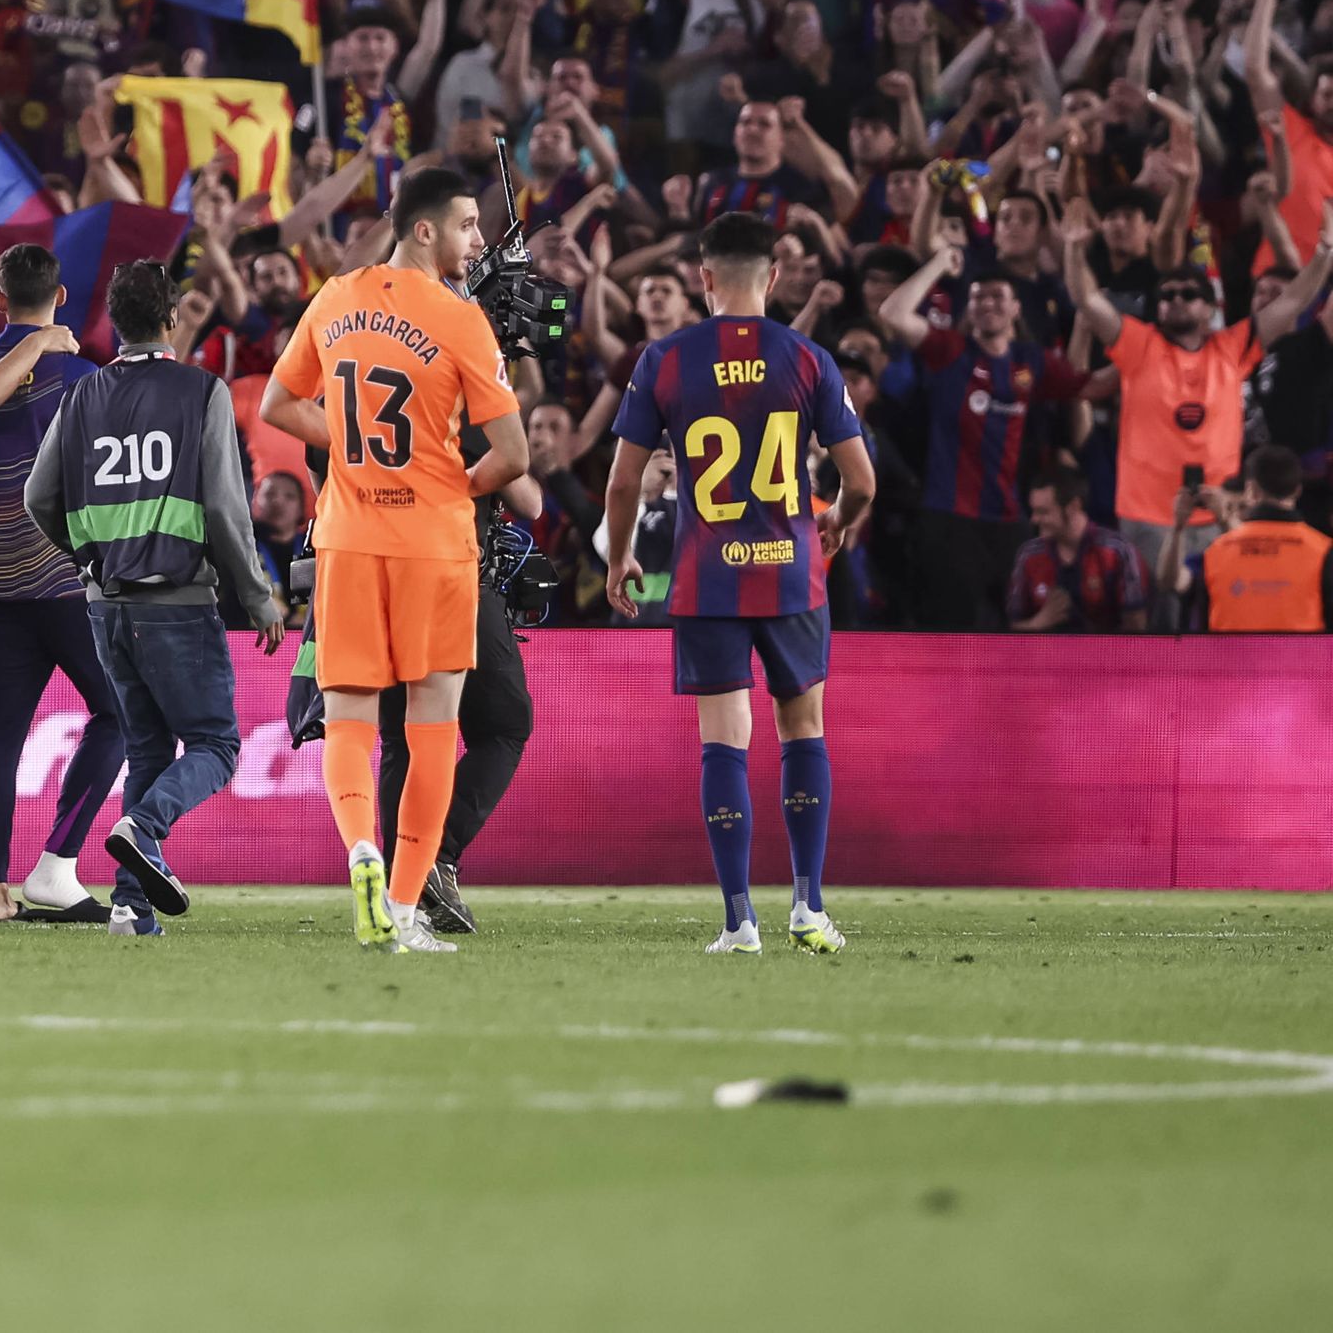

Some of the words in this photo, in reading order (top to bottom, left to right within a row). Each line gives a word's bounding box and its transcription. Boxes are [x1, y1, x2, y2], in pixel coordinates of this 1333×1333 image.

[323, 309, 367, 349] JOAN
[369, 310, 440, 366] GARCIA
[713, 359, 767, 387] ERIC
[332, 359, 415, 470] 13
[93, 430, 173, 486] 210
[685, 410, 800, 523] 24
[374, 487, 415, 497] UNHCR
[374, 496, 416, 506] ACNUR
[752, 540, 794, 551] UNHCR
[752, 549, 794, 560] ACNUR
